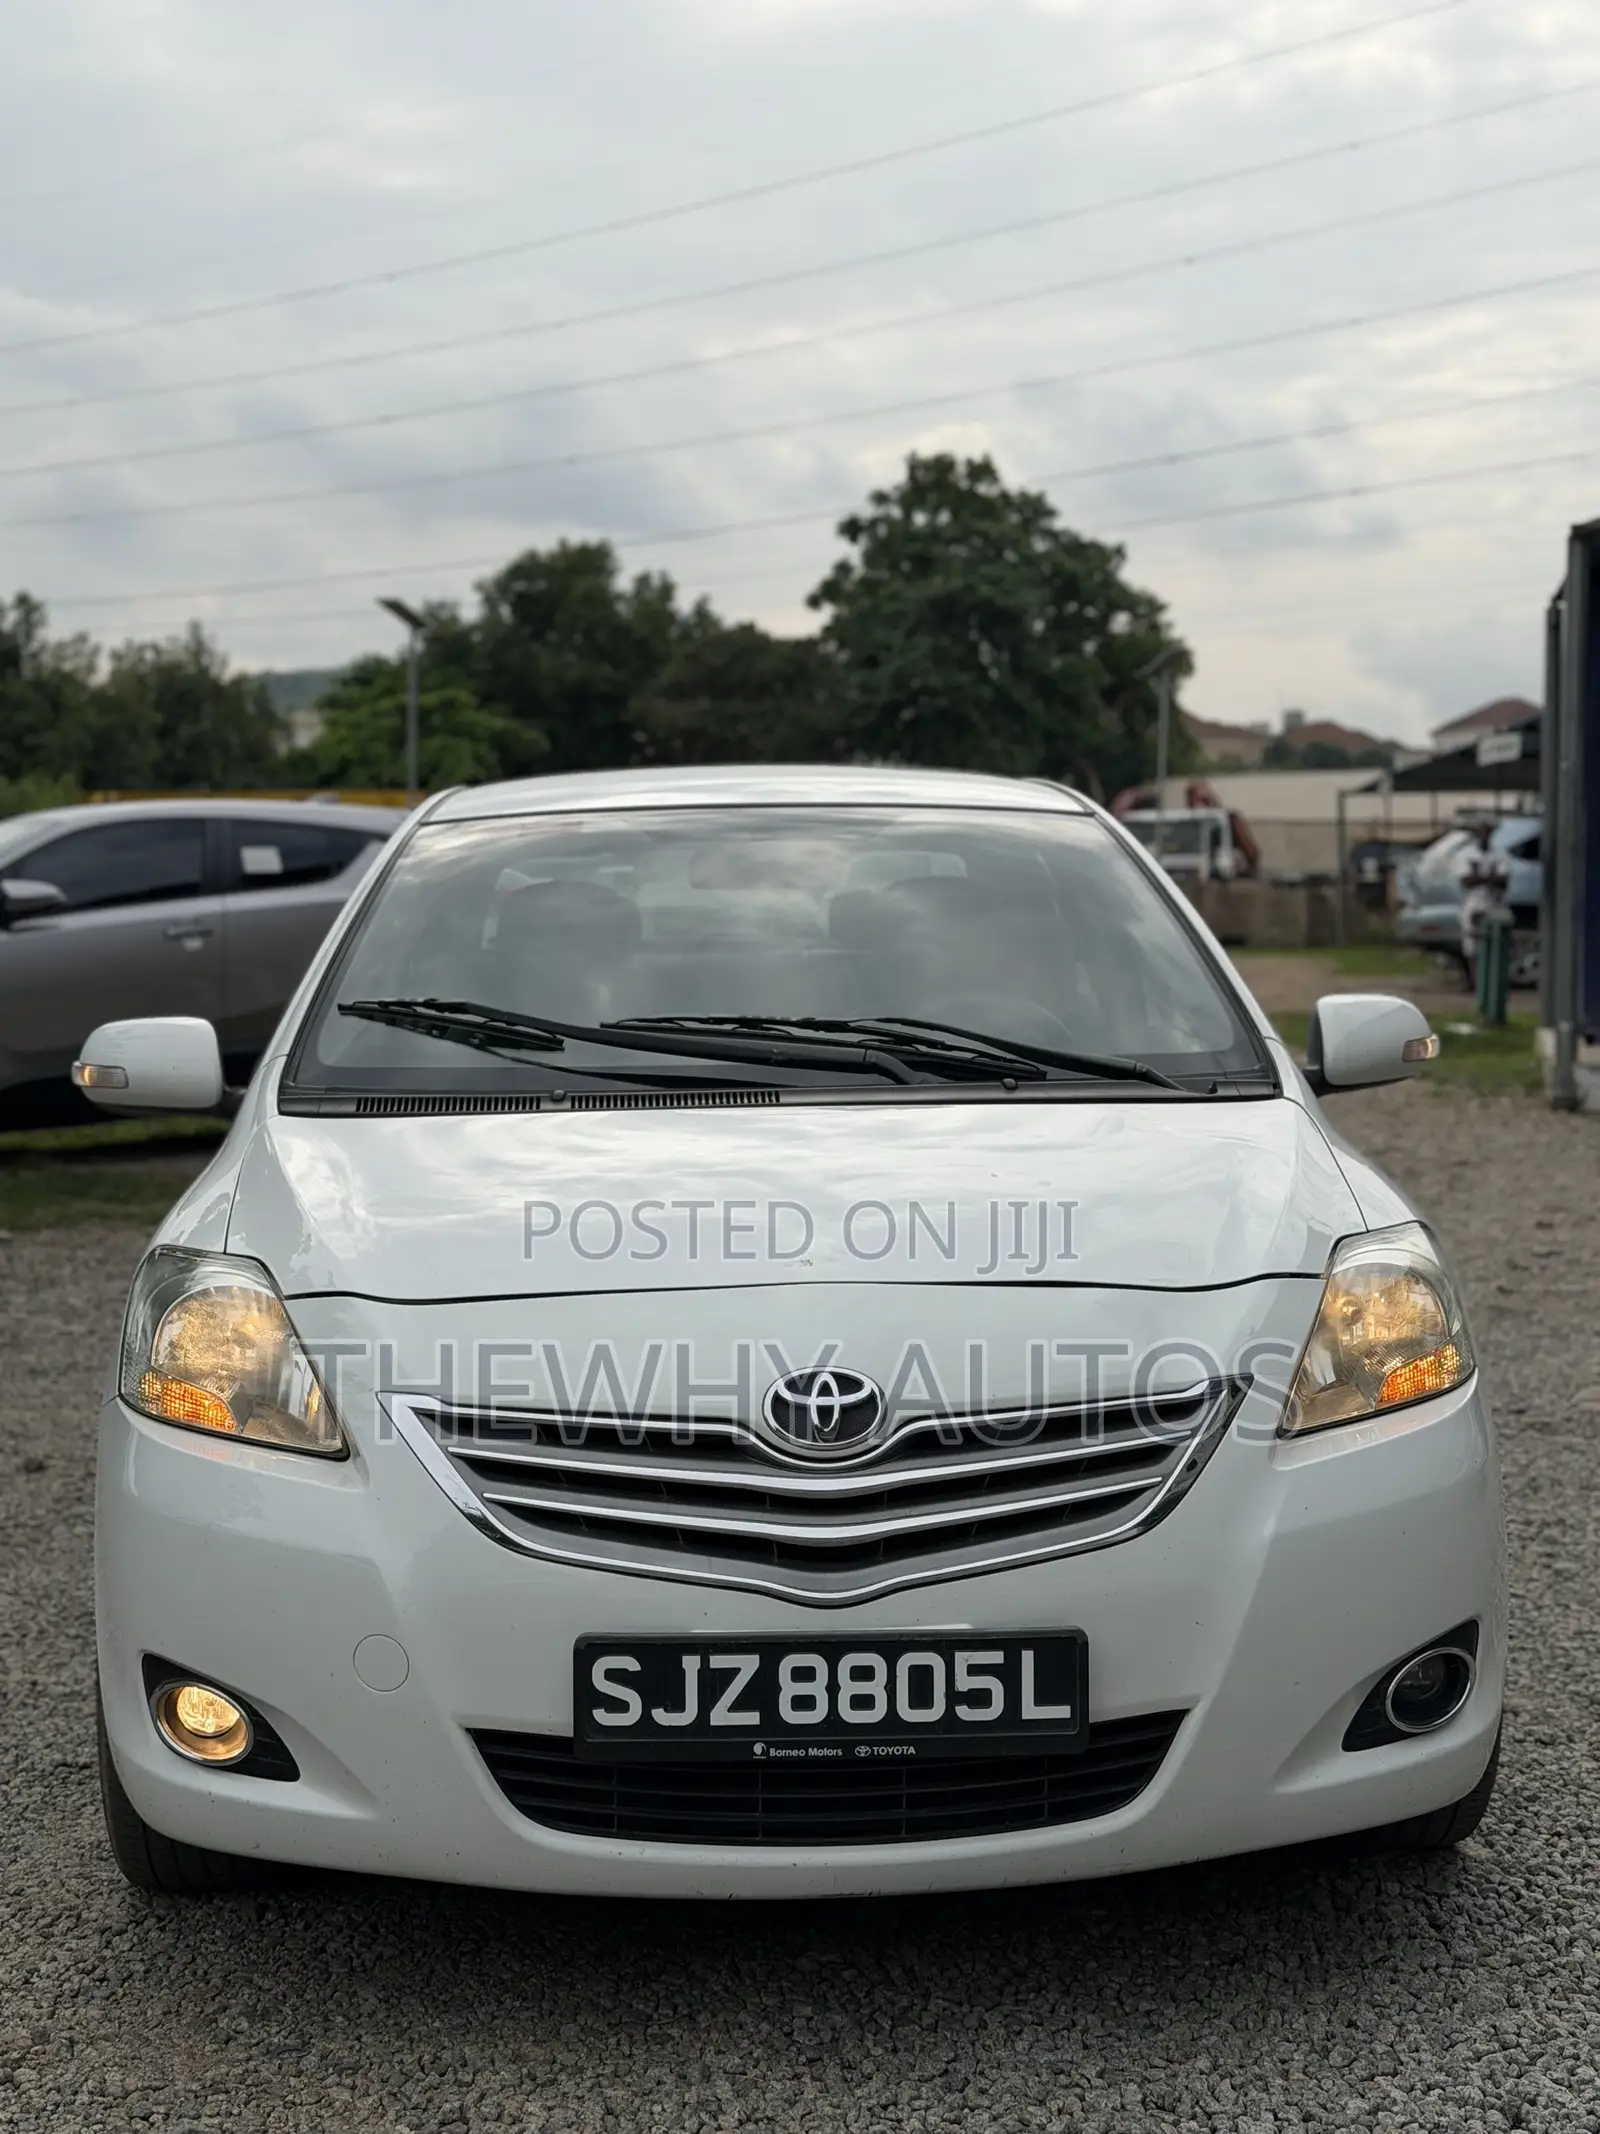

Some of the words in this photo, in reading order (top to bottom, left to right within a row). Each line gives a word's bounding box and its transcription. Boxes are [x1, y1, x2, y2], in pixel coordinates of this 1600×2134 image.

[592, 1650, 1072, 1727] SJZ8805L
[769, 1747, 806, 1757] Borneo
[808, 1747, 843, 1756] Motors
[872, 1746, 916, 1755] TOYOTA
